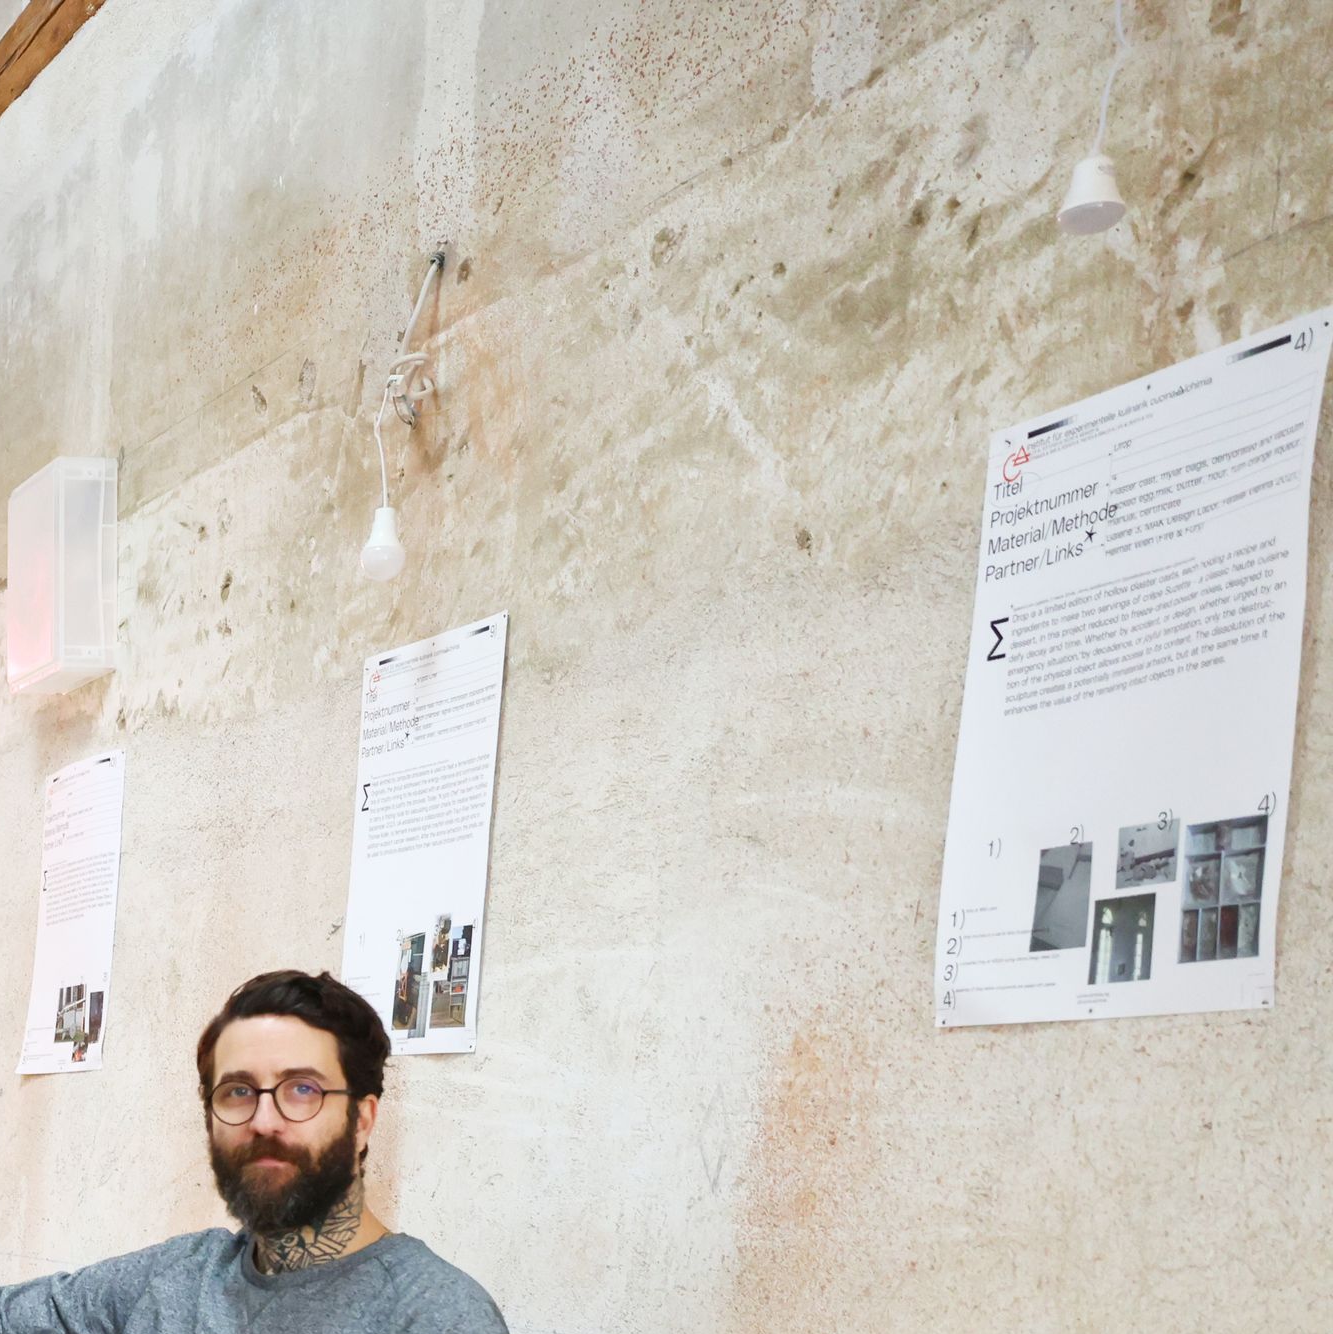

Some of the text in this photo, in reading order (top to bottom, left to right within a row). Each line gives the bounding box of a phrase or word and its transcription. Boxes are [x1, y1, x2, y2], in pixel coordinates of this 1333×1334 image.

[1294, 327, 1313, 352] 4)
[994, 477, 1022, 501] Titel
[990, 480, 1098, 529] Projektnummer
[988, 503, 1117, 556] Material/Methode
[985, 542, 1084, 583] Partner/Links
[1044, 600, 1066, 614] limited
[1068, 593, 1092, 607] edition
[1259, 535, 1276, 549] and
[1051, 616, 1059, 626] to
[1084, 628, 1117, 644] Whether
[1273, 579, 1287, 590] an
[1222, 606, 1236, 619] the
[1267, 608, 1285, 622] the
[1200, 641, 1214, 654] the
[1185, 659, 1199, 672] the
[364, 700, 411, 720] Projektnummer
[1257, 792, 1276, 816] 4)
[1158, 809, 1174, 831] 3)
[1070, 824, 1085, 845] 2)
[988, 838, 1002, 859] 1)
[951, 909, 965, 930] 1)
[947, 935, 962, 959] 2)
[943, 961, 958, 982] 3)
[942, 988, 956, 1010] 4)
